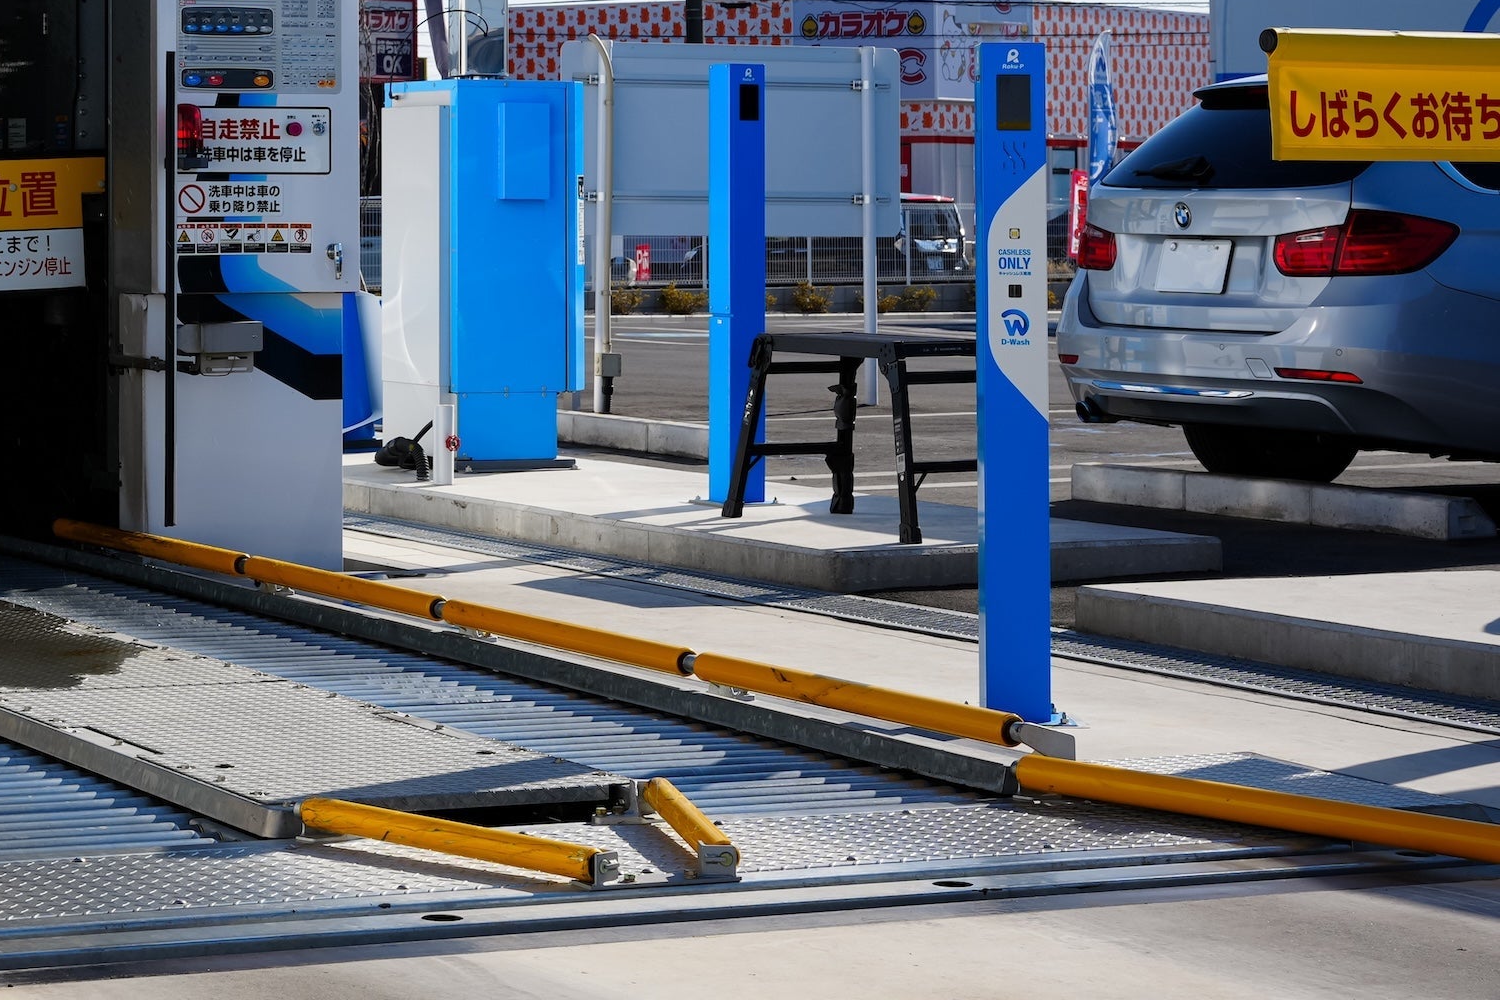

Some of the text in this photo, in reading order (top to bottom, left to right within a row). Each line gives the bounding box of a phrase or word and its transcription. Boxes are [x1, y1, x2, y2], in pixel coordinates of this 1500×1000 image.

[819, 12, 908, 38] カラオケ
[382, 55, 403, 73] OK
[1290, 89, 1500, 141] しばらくお待ち
[200, 119, 281, 140] 自走禁止
[200, 146, 306, 163] 洗車中は車を停止
[208, 185, 280, 198] 洗車中は車の
[208, 200, 281, 213] 乗り降り禁止
[998, 248, 1031, 256] CASHLESS
[998, 257, 1031, 270] ONLY
[1001, 338, 1030, 346] D-Wash
